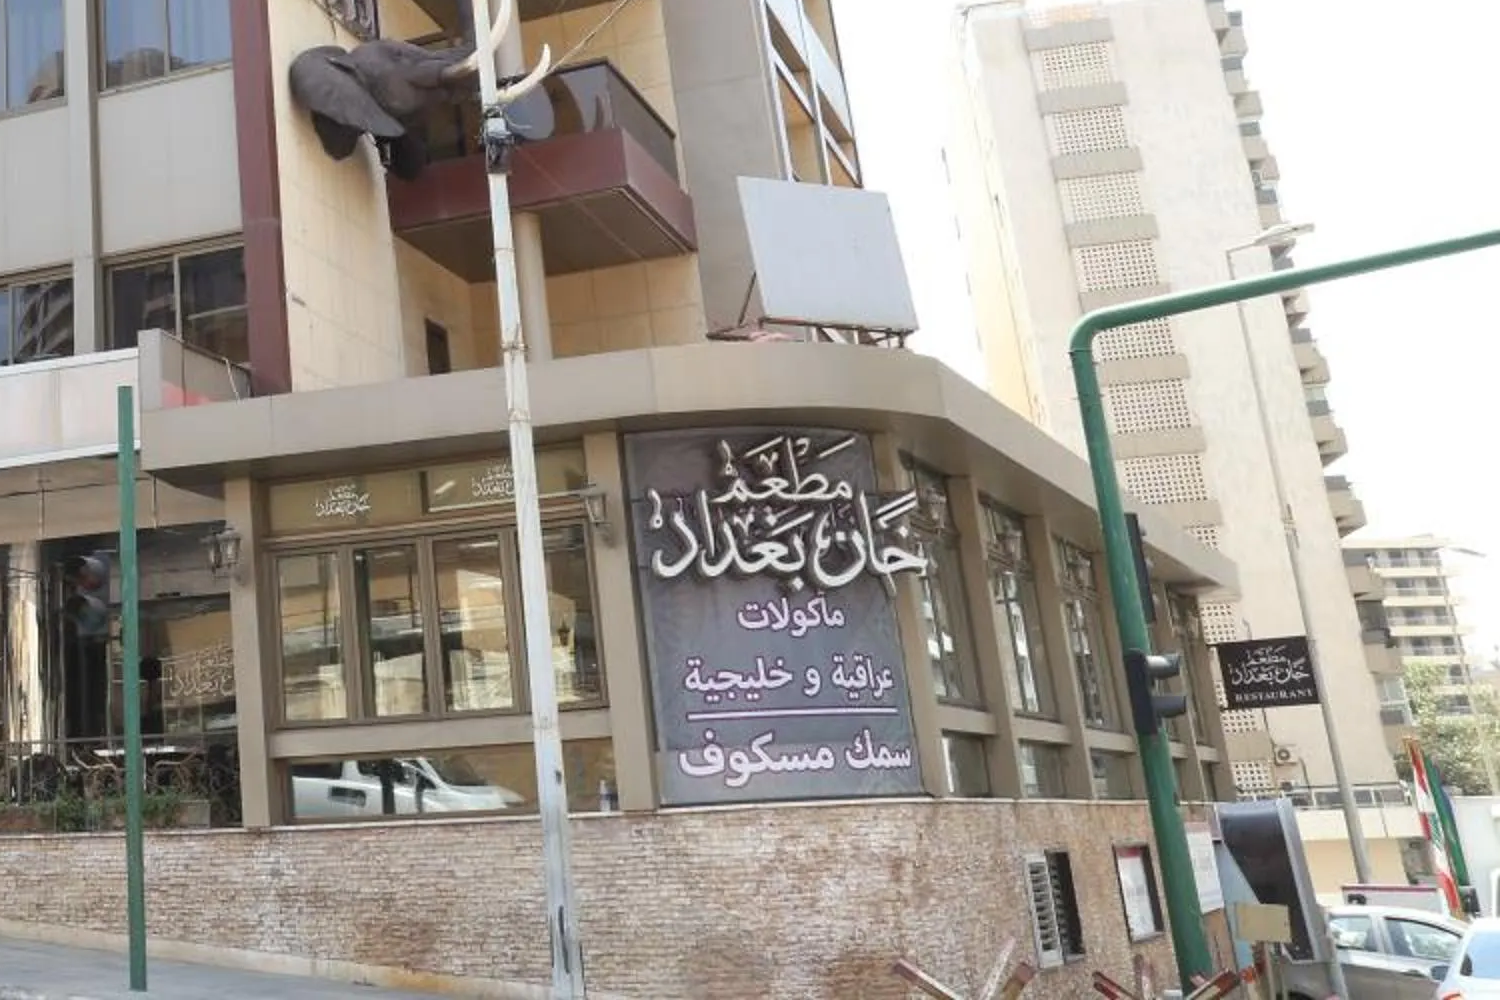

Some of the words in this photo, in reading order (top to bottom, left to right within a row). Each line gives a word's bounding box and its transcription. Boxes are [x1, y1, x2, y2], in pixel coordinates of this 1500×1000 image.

[712, 437, 856, 503] مطعم
[649, 488, 808, 591] بغداد
[813, 488, 929, 588] خان
[737, 592, 846, 637] مأكولات
[684, 657, 793, 701] خليجية
[803, 666, 822, 696] و
[831, 655, 894, 699] عراقية
[1228, 661, 1275, 685] بغداد
[1235, 688, 1313, 702] RESTAURANT
[678, 730, 835, 787] مسكوف
[845, 729, 912, 769] سمك
